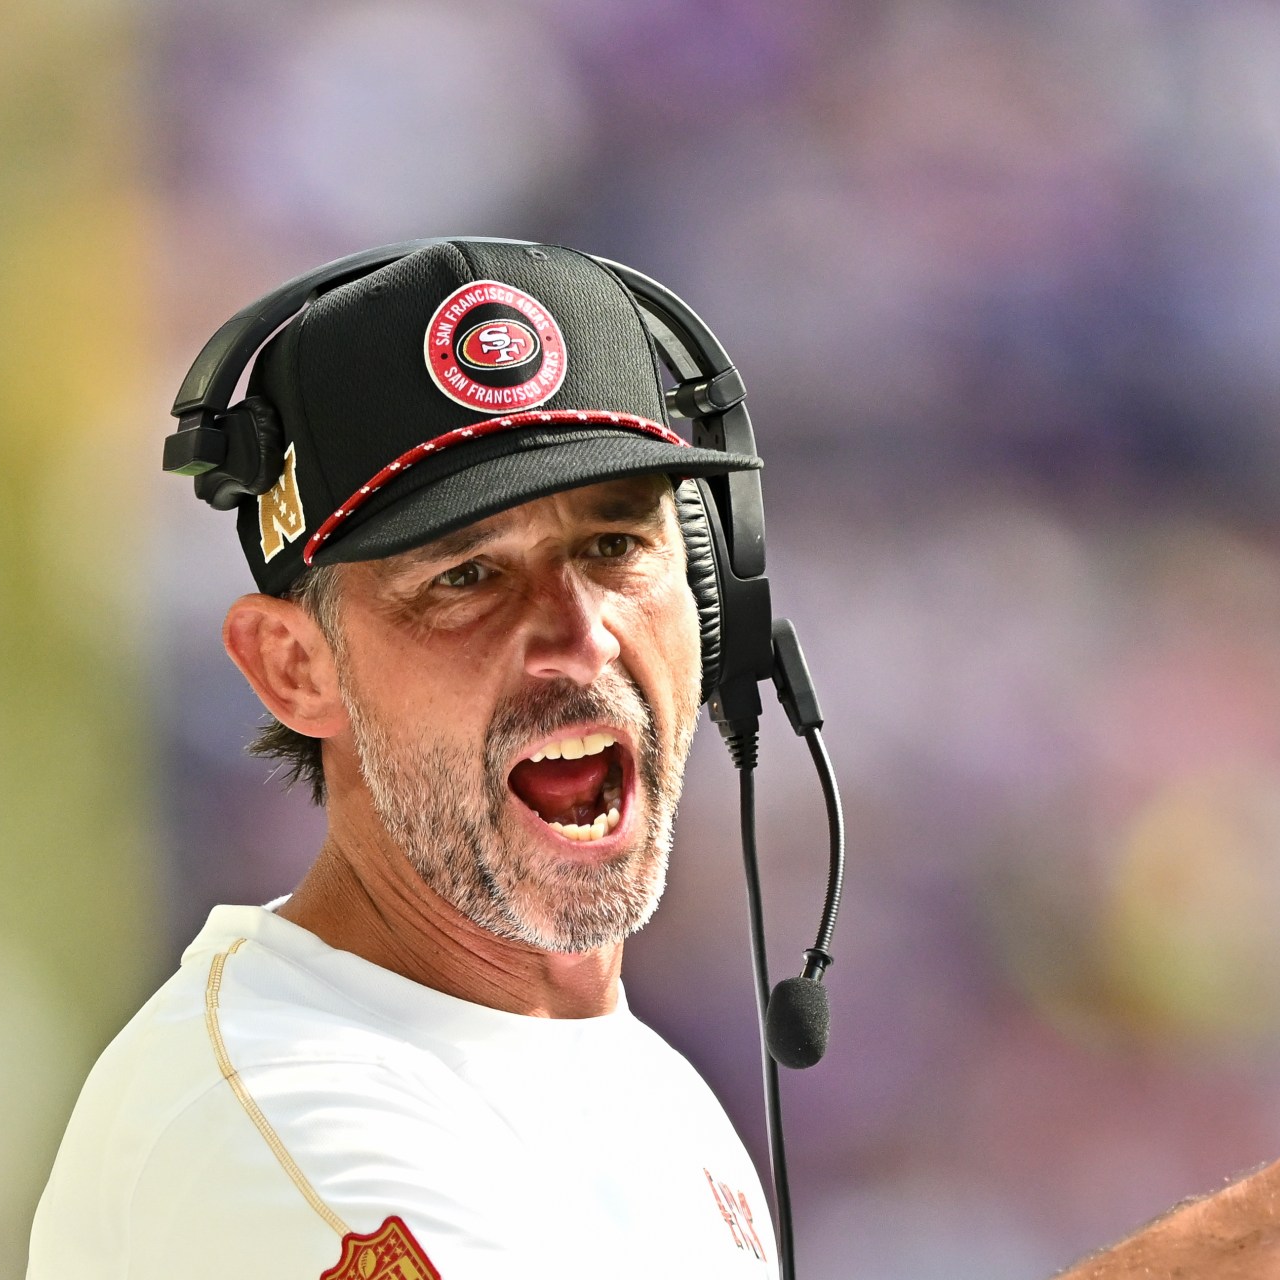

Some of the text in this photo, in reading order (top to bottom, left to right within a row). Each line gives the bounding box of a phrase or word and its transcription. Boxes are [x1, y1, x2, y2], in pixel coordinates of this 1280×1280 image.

[436, 288, 550, 346] SAN FRANCISCO 49ERS
[478, 326, 526, 363] SF
[444, 351, 559, 404] SAN FRANCISCO 49ERS
